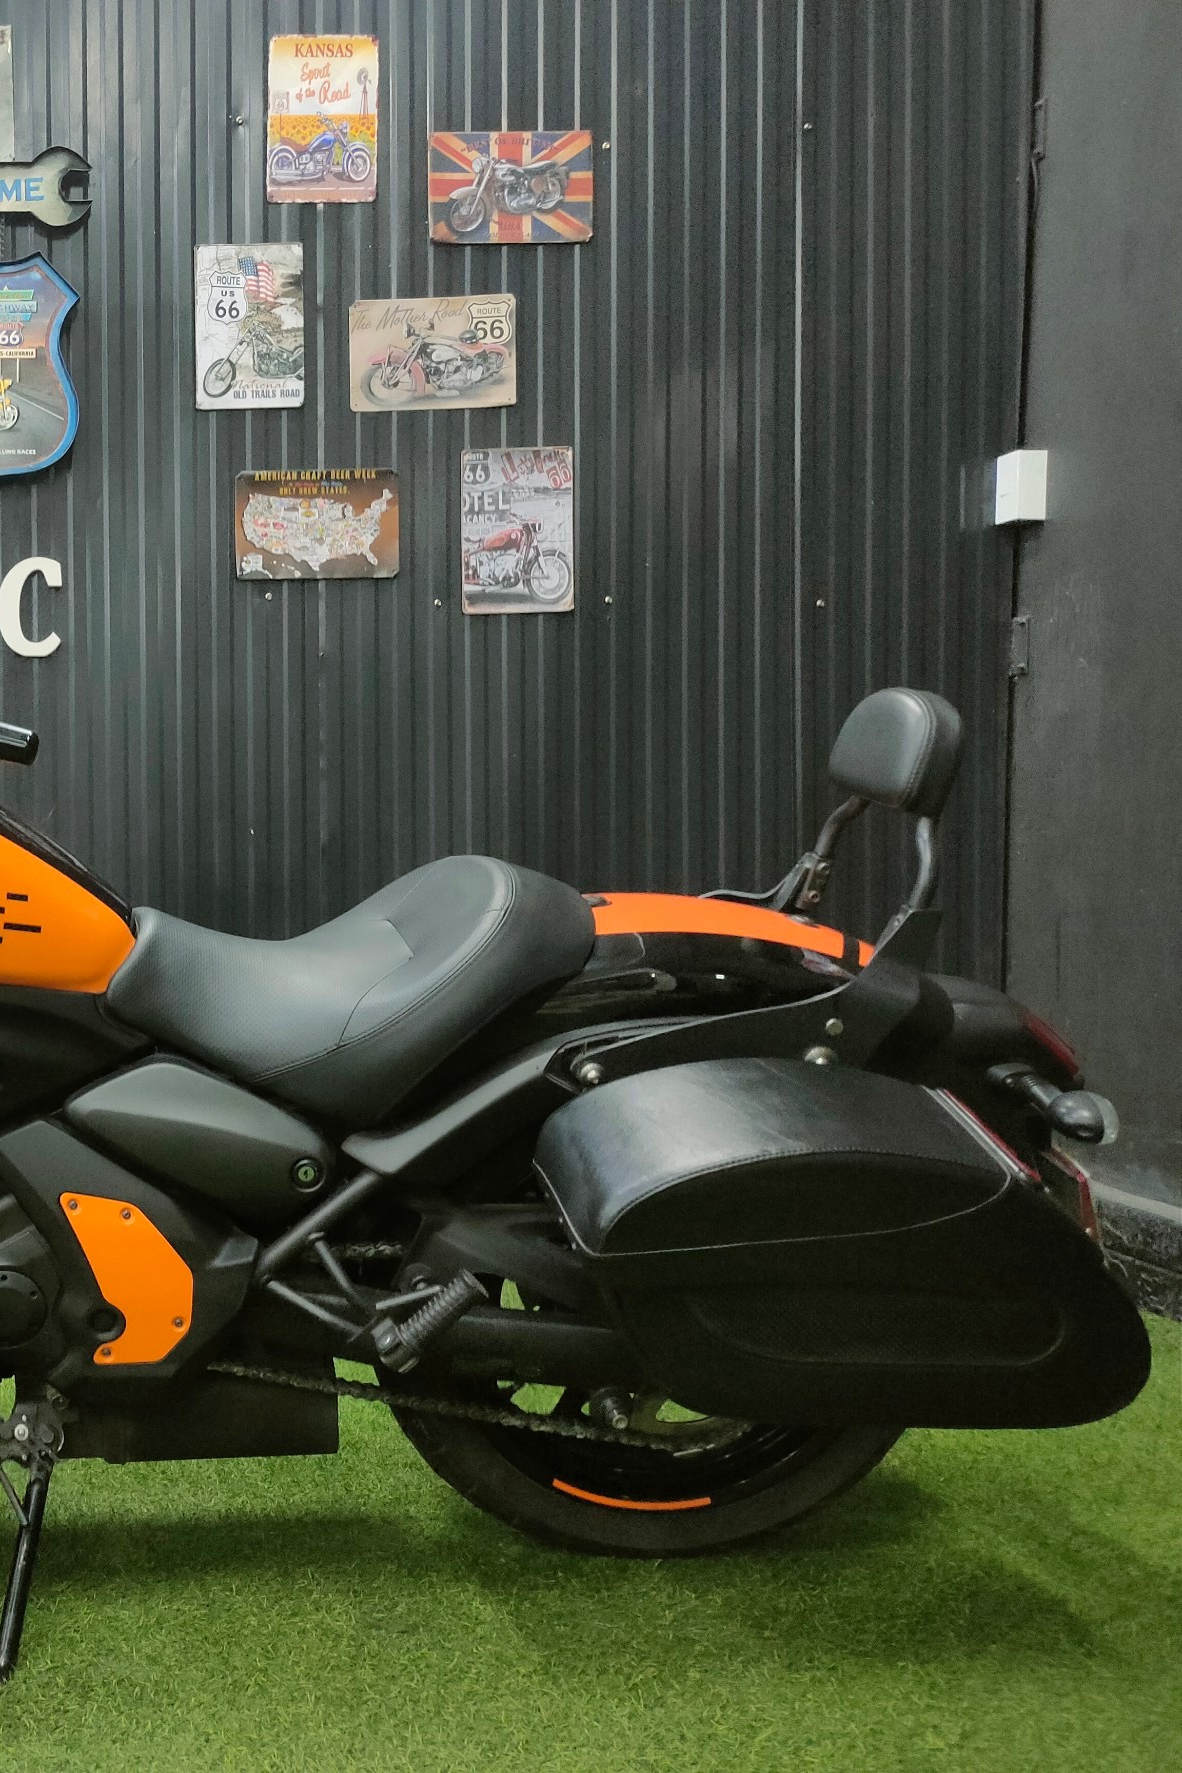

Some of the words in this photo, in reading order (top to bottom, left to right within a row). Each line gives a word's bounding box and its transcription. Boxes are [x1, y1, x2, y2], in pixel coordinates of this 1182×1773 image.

[294, 43, 353, 58] KANSAS
[300, 62, 331, 85] Spirit
[318, 80, 351, 105] Road
[216, 276, 241, 286] ROUTE
[215, 299, 240, 319] 66
[351, 309, 370, 334] The
[375, 304, 428, 331] Mother
[433, 299, 468, 322] Road
[476, 308, 502, 316] ROUTE
[474, 318, 505, 341] 66
[233, 389, 247, 399] OLD
[251, 388, 277, 399] TRAILS
[280, 388, 300, 398] ROAD
[464, 464, 486, 483] 66
[548, 462, 571, 489] 66
